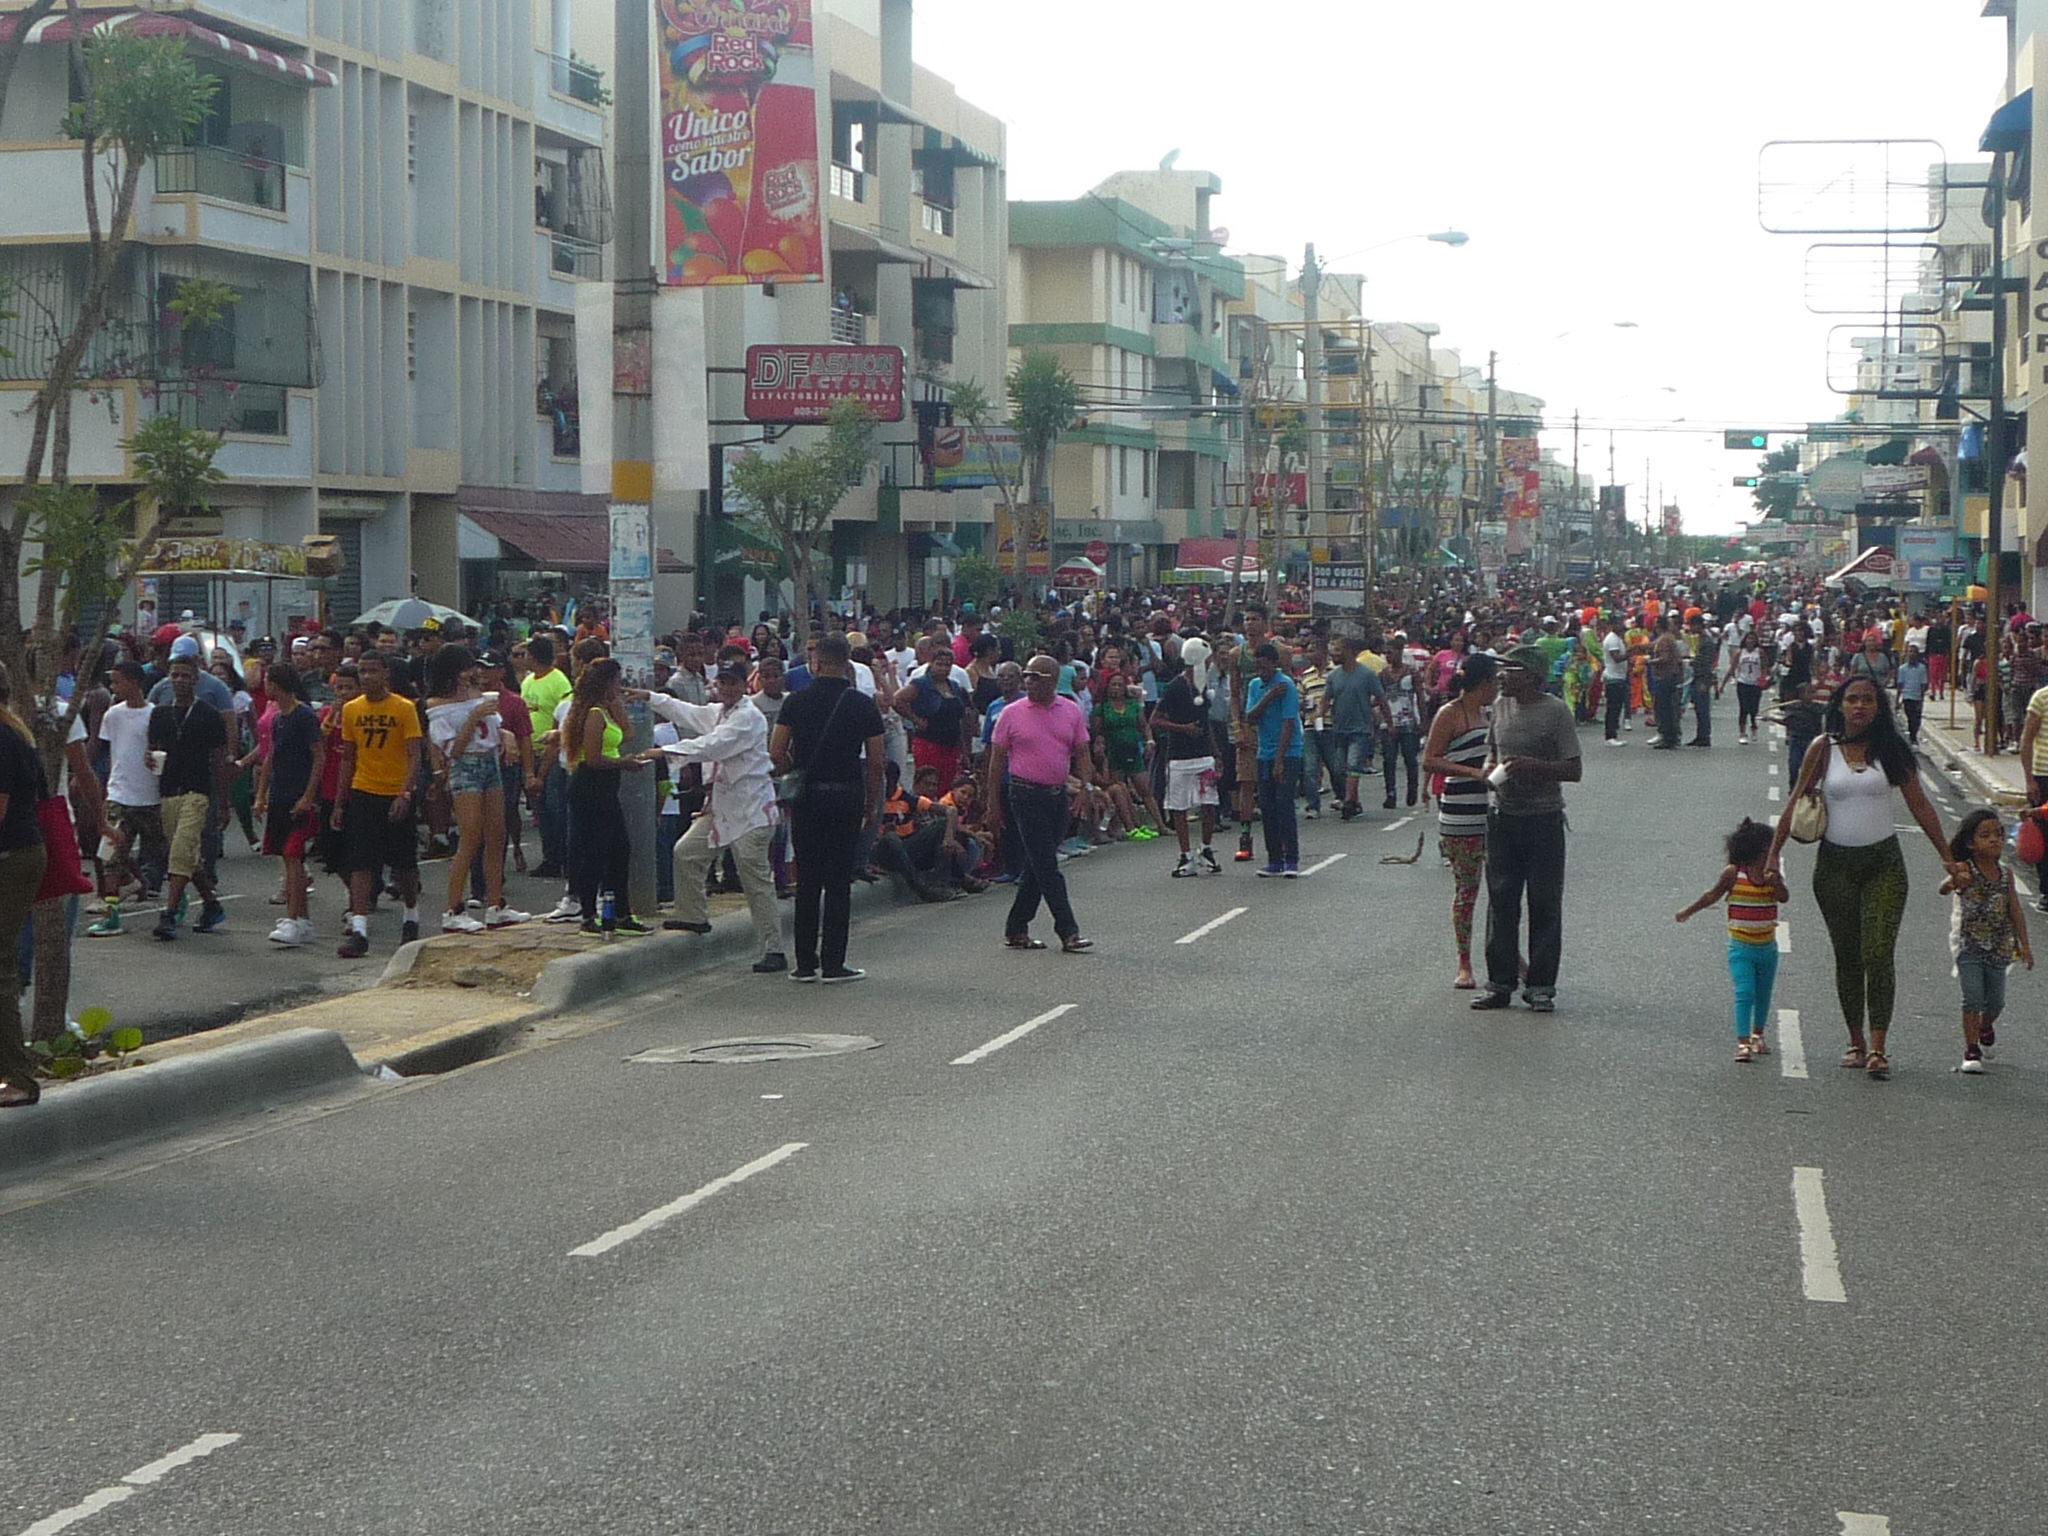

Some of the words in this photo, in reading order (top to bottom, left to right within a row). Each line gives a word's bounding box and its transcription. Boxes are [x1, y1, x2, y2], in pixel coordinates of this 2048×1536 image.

[711, 32, 758, 52] Red
[707, 51, 765, 72] Rock
[668, 103, 748, 141] Único
[668, 140, 701, 154] como
[705, 130, 751, 147] nuestro
[671, 147, 752, 182] Sabor
[180, 557, 222, 569] Pollo
[363, 728, 389, 749] 77
